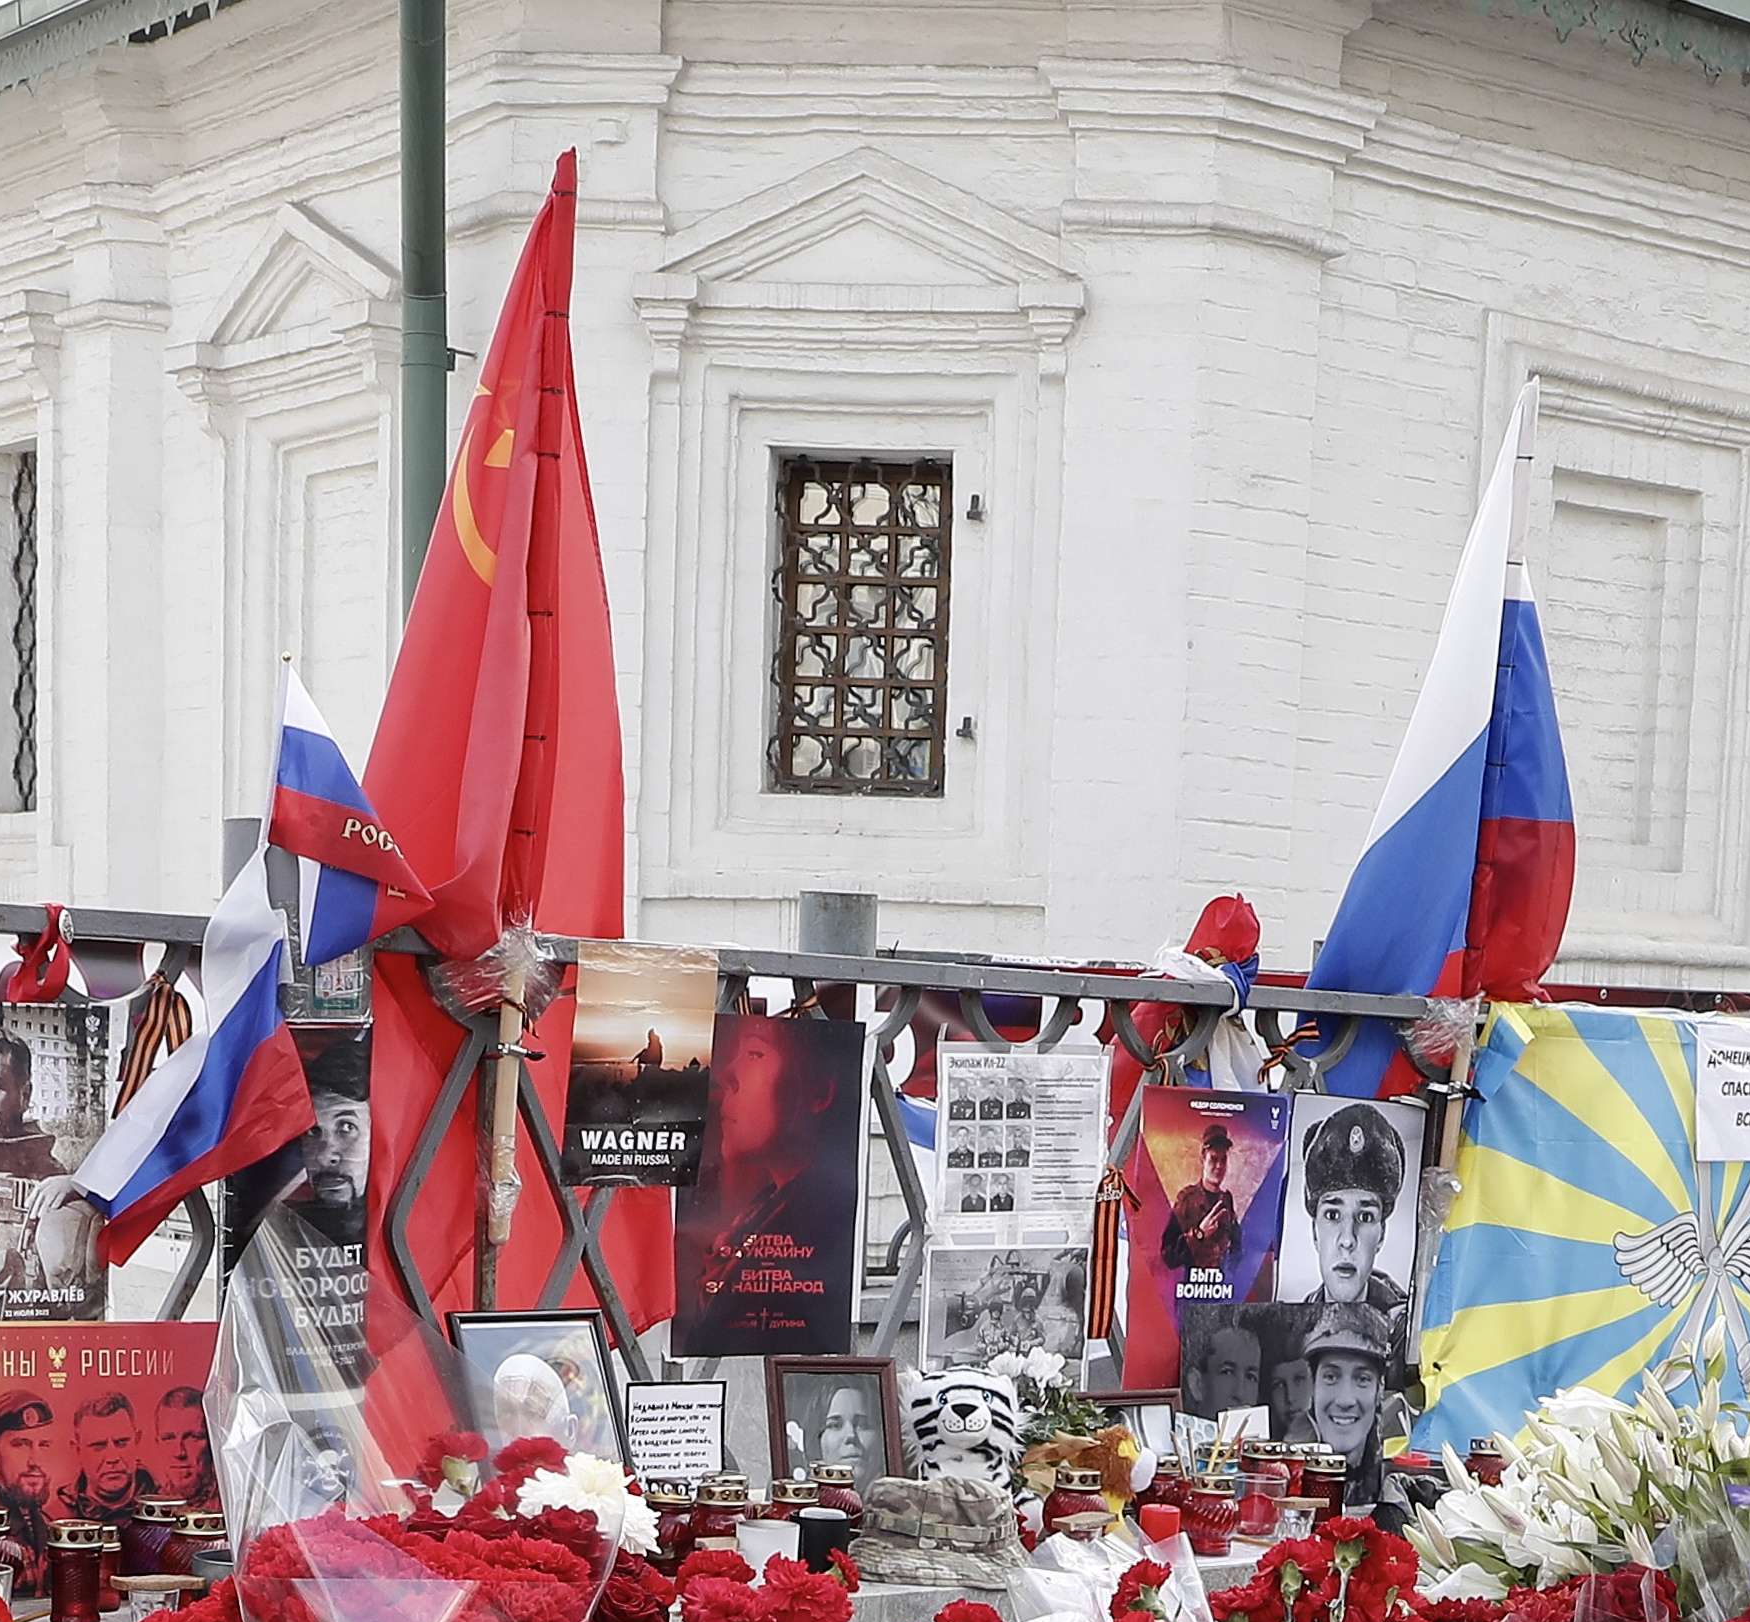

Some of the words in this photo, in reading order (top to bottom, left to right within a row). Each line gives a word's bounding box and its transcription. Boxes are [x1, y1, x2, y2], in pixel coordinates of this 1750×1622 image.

[581, 1130, 686, 1151] WAGNER
[591, 1153, 621, 1166] MADE
[623, 1153, 633, 1166] IN
[634, 1153, 671, 1166] RUSSIA
[295, 1244, 363, 1269] БУДЕТ
[745, 1247, 815, 1258] УКРАИНУ
[741, 1269, 793, 1281] БИТВА
[1190, 1268, 1224, 1283] БЫТЬ
[7, 1285, 85, 1304] ЖУРАВЛЁВ
[771, 1281, 825, 1294] НАРОД
[1176, 1283, 1233, 1299] ВОИНОМ
[293, 1301, 365, 1328] БУДЕТ!
[81, 1349, 174, 1377] РОССИИ
